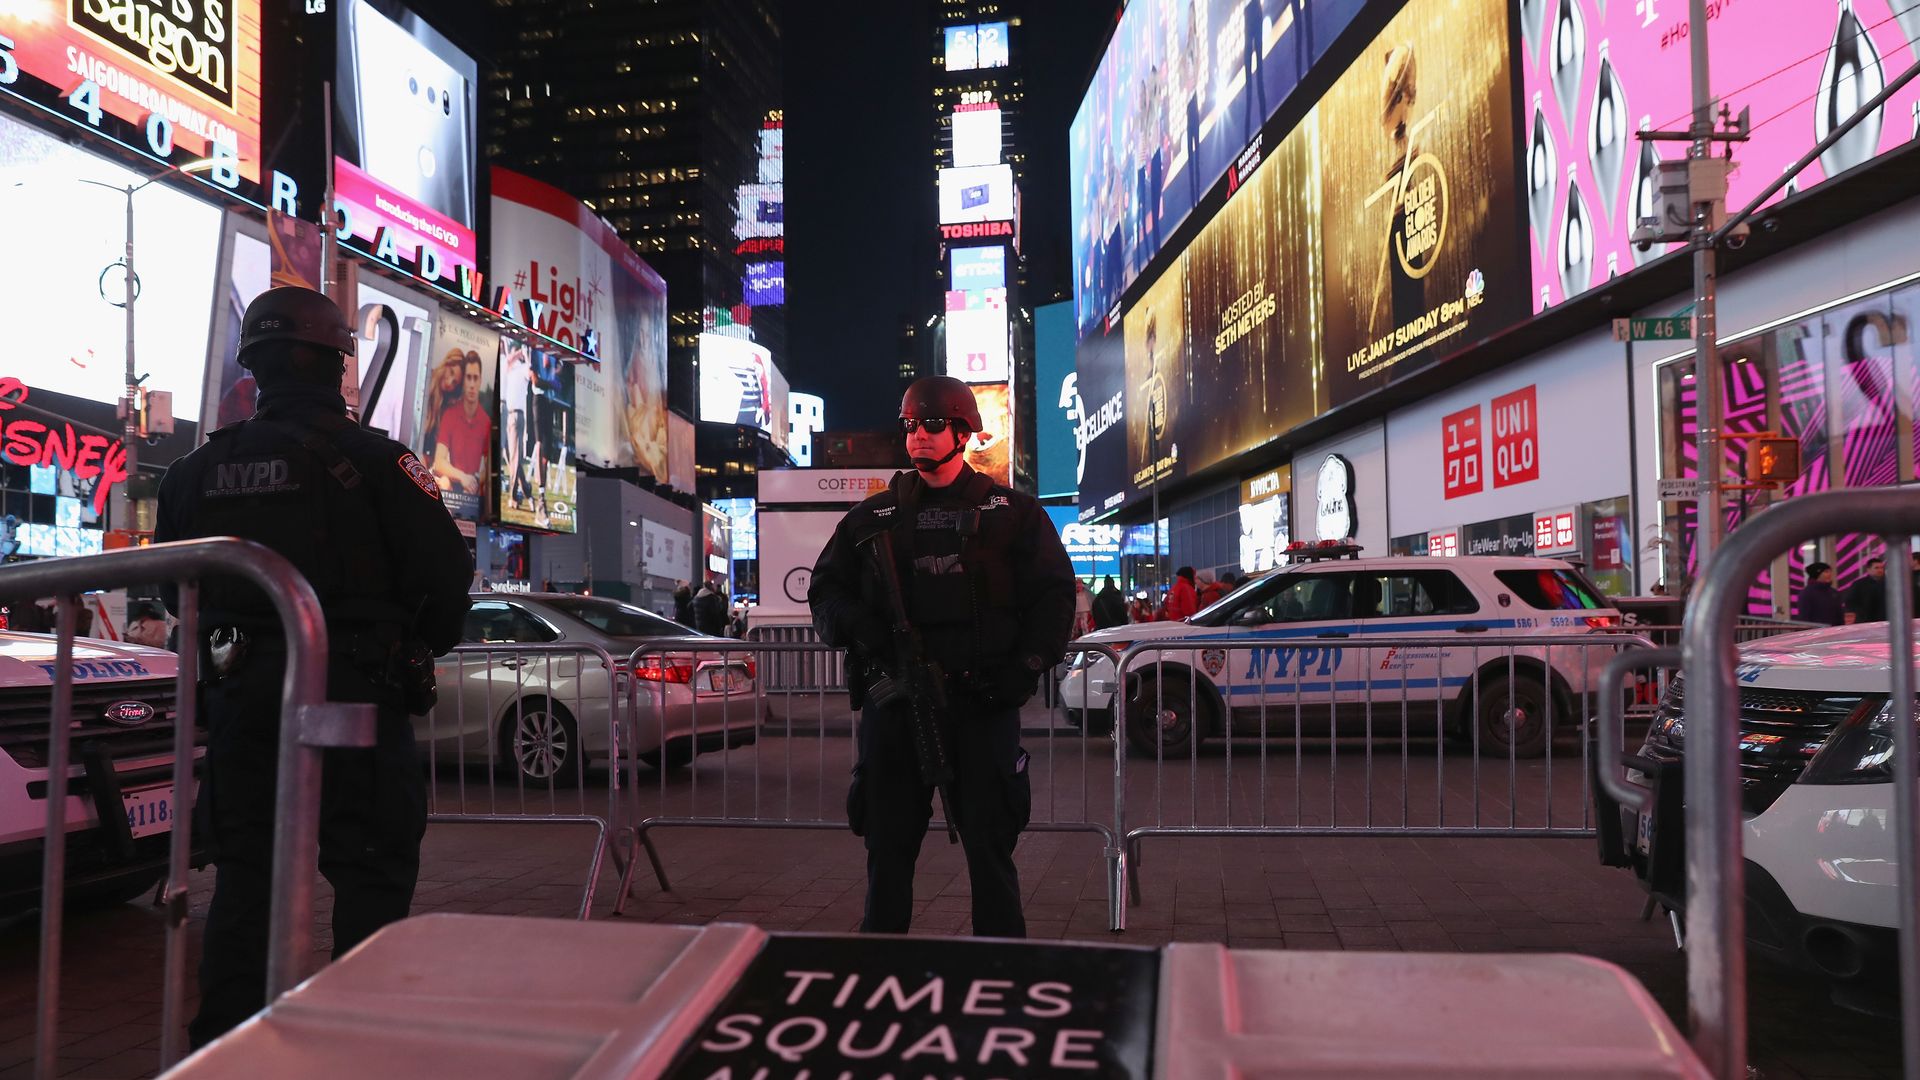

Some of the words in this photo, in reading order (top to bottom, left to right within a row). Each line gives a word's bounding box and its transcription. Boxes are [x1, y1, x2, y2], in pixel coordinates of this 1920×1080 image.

[954, 102, 999, 113] TOSHIBA
[1238, 134, 1263, 170] MARRIOTT
[1405, 173, 1436, 216] GOLDEN
[941, 222, 1013, 238] TOSHIBA
[1405, 196, 1437, 239] GLOBE
[1406, 221, 1438, 263] AWARDS
[1222, 289, 1254, 329] HOSTED
[1254, 278, 1265, 304] BY
[1467, 293, 1484, 310] NBC
[1215, 323, 1237, 355] SETH
[1237, 293, 1276, 339] MEYERS
[1347, 348, 1368, 372] LIVE
[1367, 337, 1388, 362] JAN
[1387, 332, 1396, 352] 7
[1395, 307, 1440, 347] SUNDAY
[1440, 297, 1464, 323] 8PM
[1633, 322, 1646, 338] W
[1654, 320, 1674, 337] 46
[1448, 418, 1476, 452] ユニ
[1496, 399, 1529, 438] UNI
[217, 458, 289, 489] NYPD
[1448, 453, 1478, 489] クロ
[1497, 437, 1534, 480] QLO
[817, 477, 886, 490] COFFEED
[1468, 535, 1500, 554] LifeWear
[1503, 531, 1534, 551] Pop-Up
[1517, 618, 1532, 628] SRG
[1245, 646, 1343, 680] NYPD
[120, 703, 146, 719] Ford
[784, 970, 1074, 1018] TIMES
[701, 1013, 1105, 1063] SQUARE
